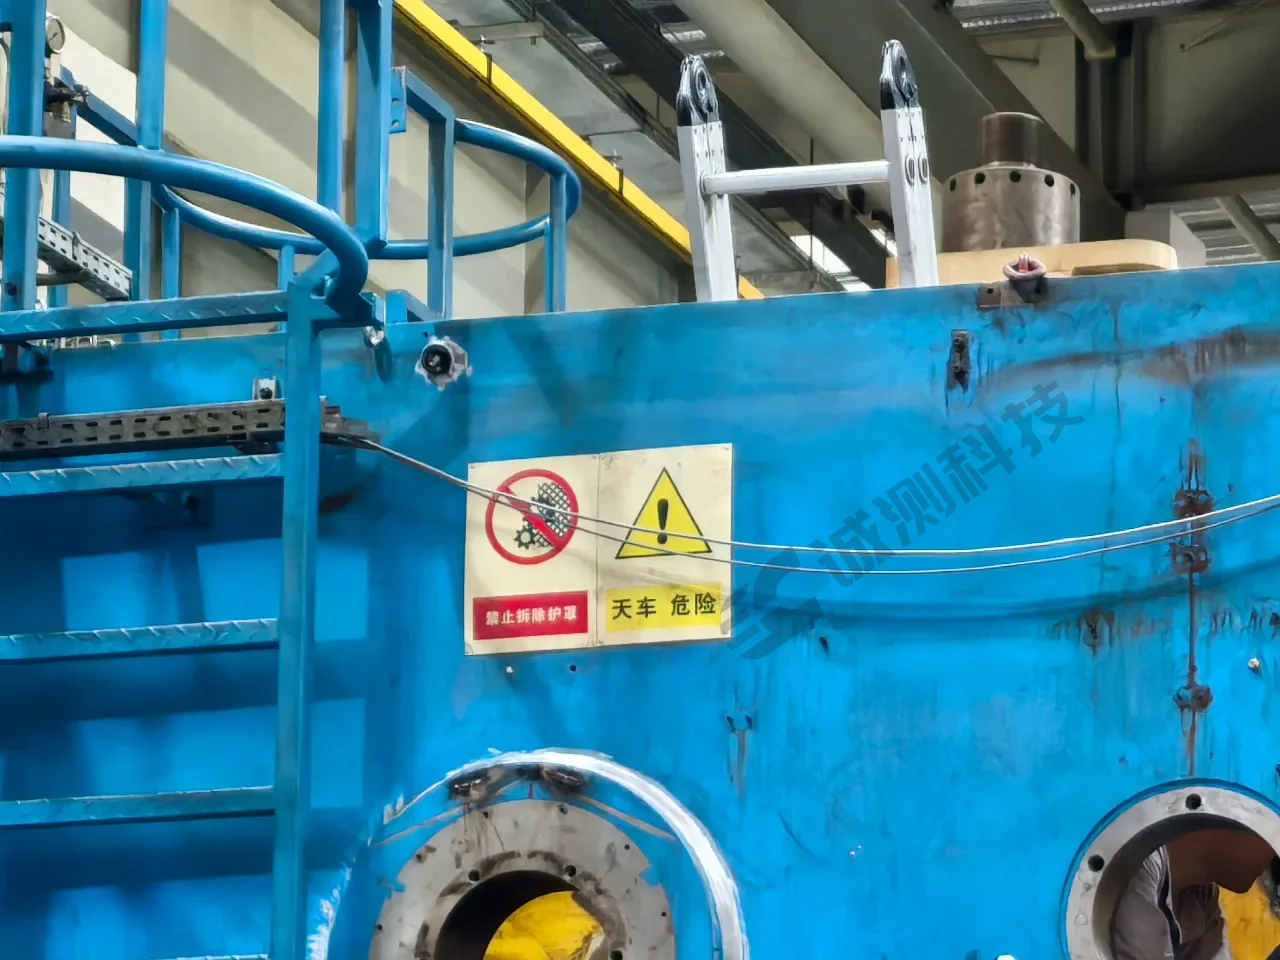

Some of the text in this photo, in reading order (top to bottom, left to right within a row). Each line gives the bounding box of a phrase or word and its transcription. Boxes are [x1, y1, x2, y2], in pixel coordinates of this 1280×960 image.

[485, 604, 577, 627] 禁止拆除护罩
[612, 592, 717, 620] 天车 危险
